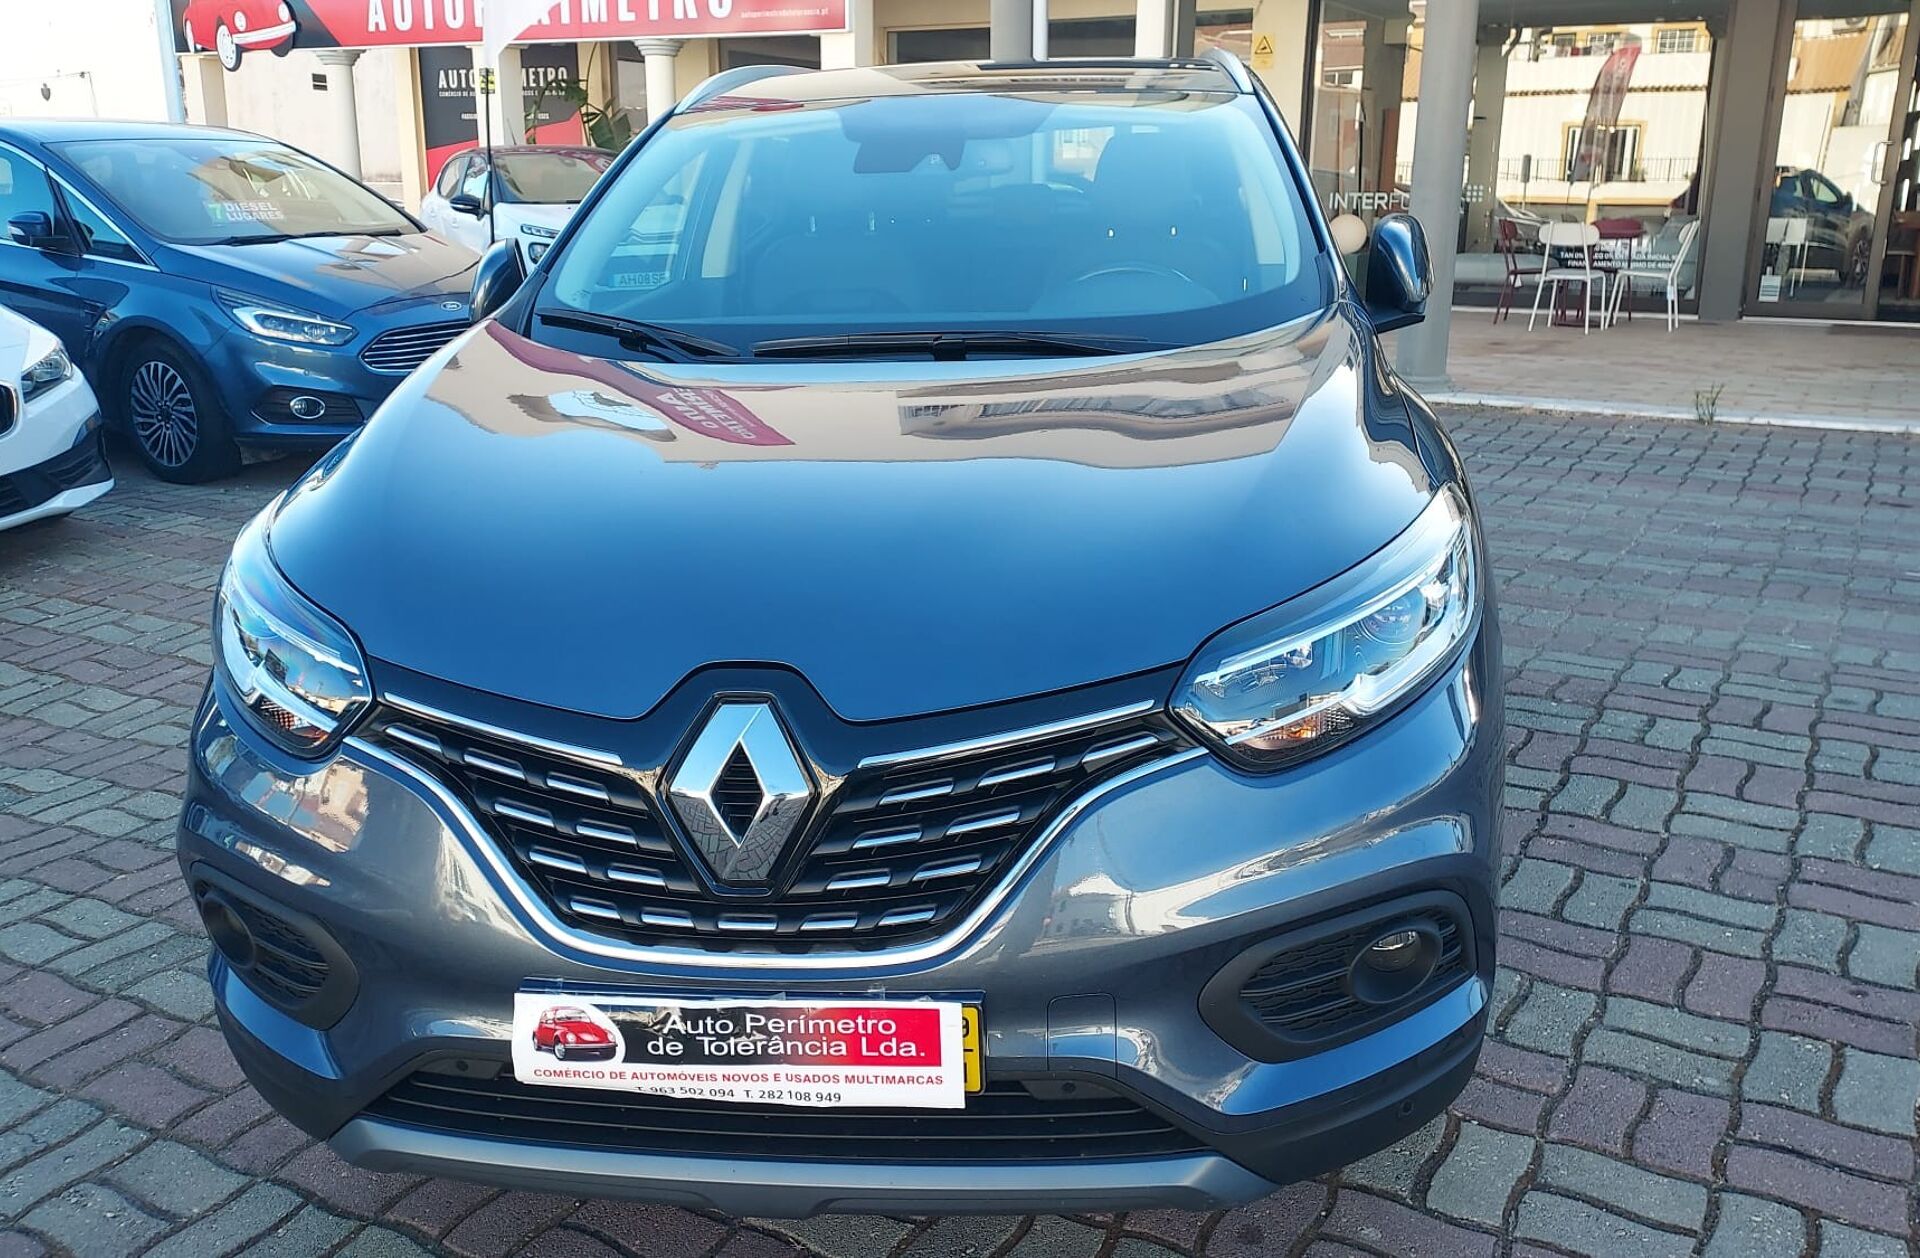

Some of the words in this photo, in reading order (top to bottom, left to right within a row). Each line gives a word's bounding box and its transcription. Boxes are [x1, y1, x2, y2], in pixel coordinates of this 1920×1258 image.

[223, 202, 278, 212] DIESEL
[225, 210, 284, 221] LUGARES
[663, 1013, 733, 1035] Auto
[745, 1013, 896, 1035] Perímetro
[647, 1036, 683, 1056] de
[696, 1035, 847, 1057] Tolerância
[861, 1037, 926, 1057] Lda.
[533, 1067, 605, 1080] COMÉRCIO
[609, 1071, 627, 1080] DE
[631, 1070, 718, 1082] AUTOMÓVEIS
[722, 1073, 769, 1083] NOVOS
[773, 1073, 781, 1082] E
[785, 1073, 840, 1084] USADOS
[844, 1075, 943, 1085] MULTIMARCAS
[649, 1086, 676, 1095] 963
[680, 1086, 704, 1096] 502
[709, 1088, 735, 1098] 094
[744, 1089, 754, 1099] T.
[759, 1089, 784, 1100] 282
[787, 1090, 811, 1102] 108
[815, 1092, 841, 1103] 949
